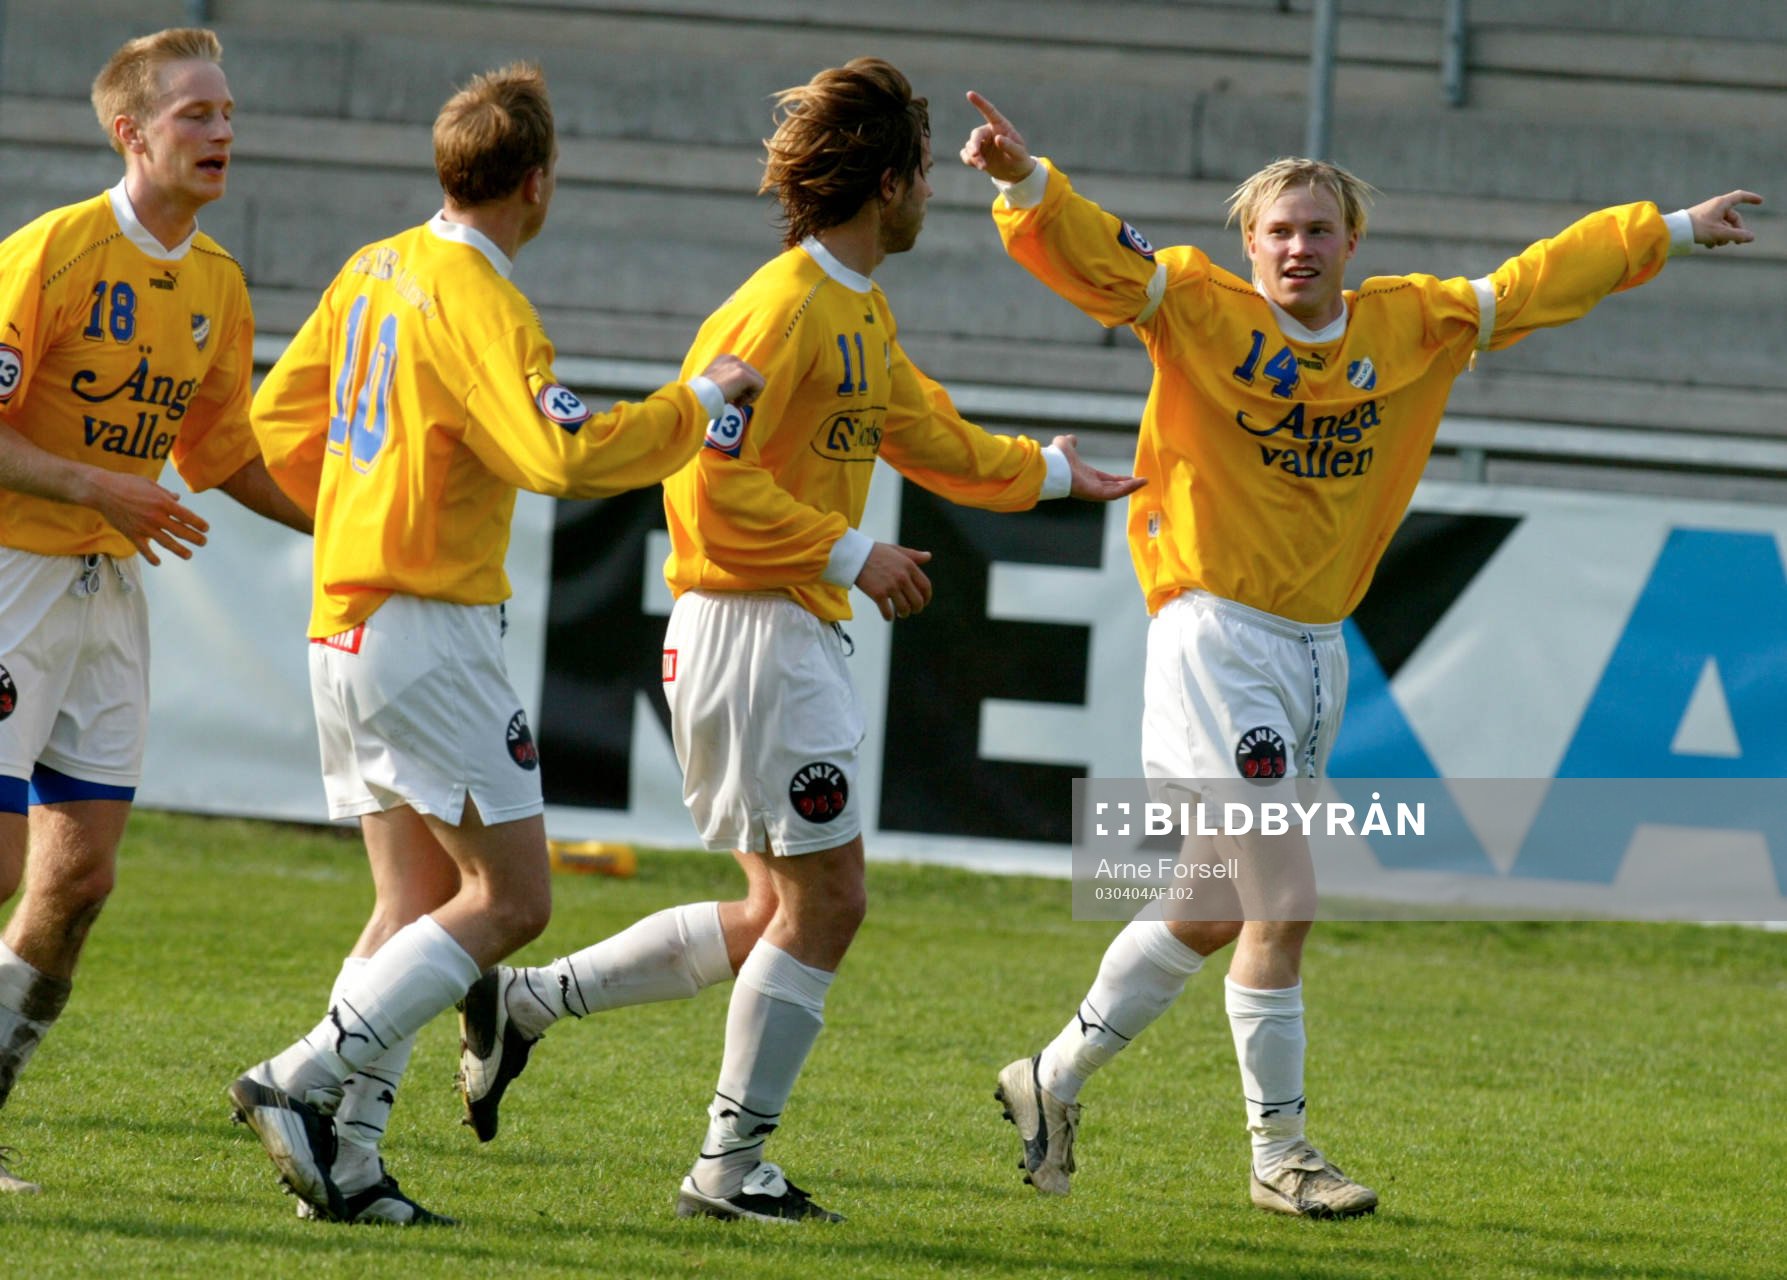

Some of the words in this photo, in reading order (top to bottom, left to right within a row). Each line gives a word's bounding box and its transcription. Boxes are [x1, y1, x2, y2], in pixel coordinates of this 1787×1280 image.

[83, 280, 136, 344] 18
[71, 345, 201, 421] Äng
[327, 295, 398, 474] 10
[837, 332, 868, 396] 11
[1232, 329, 1300, 401] 14
[552, 391, 580, 415] 13
[1257, 440, 1374, 478] vallen
[1238, 729, 1284, 755] VINYL
[792, 765, 840, 792] VINYL
